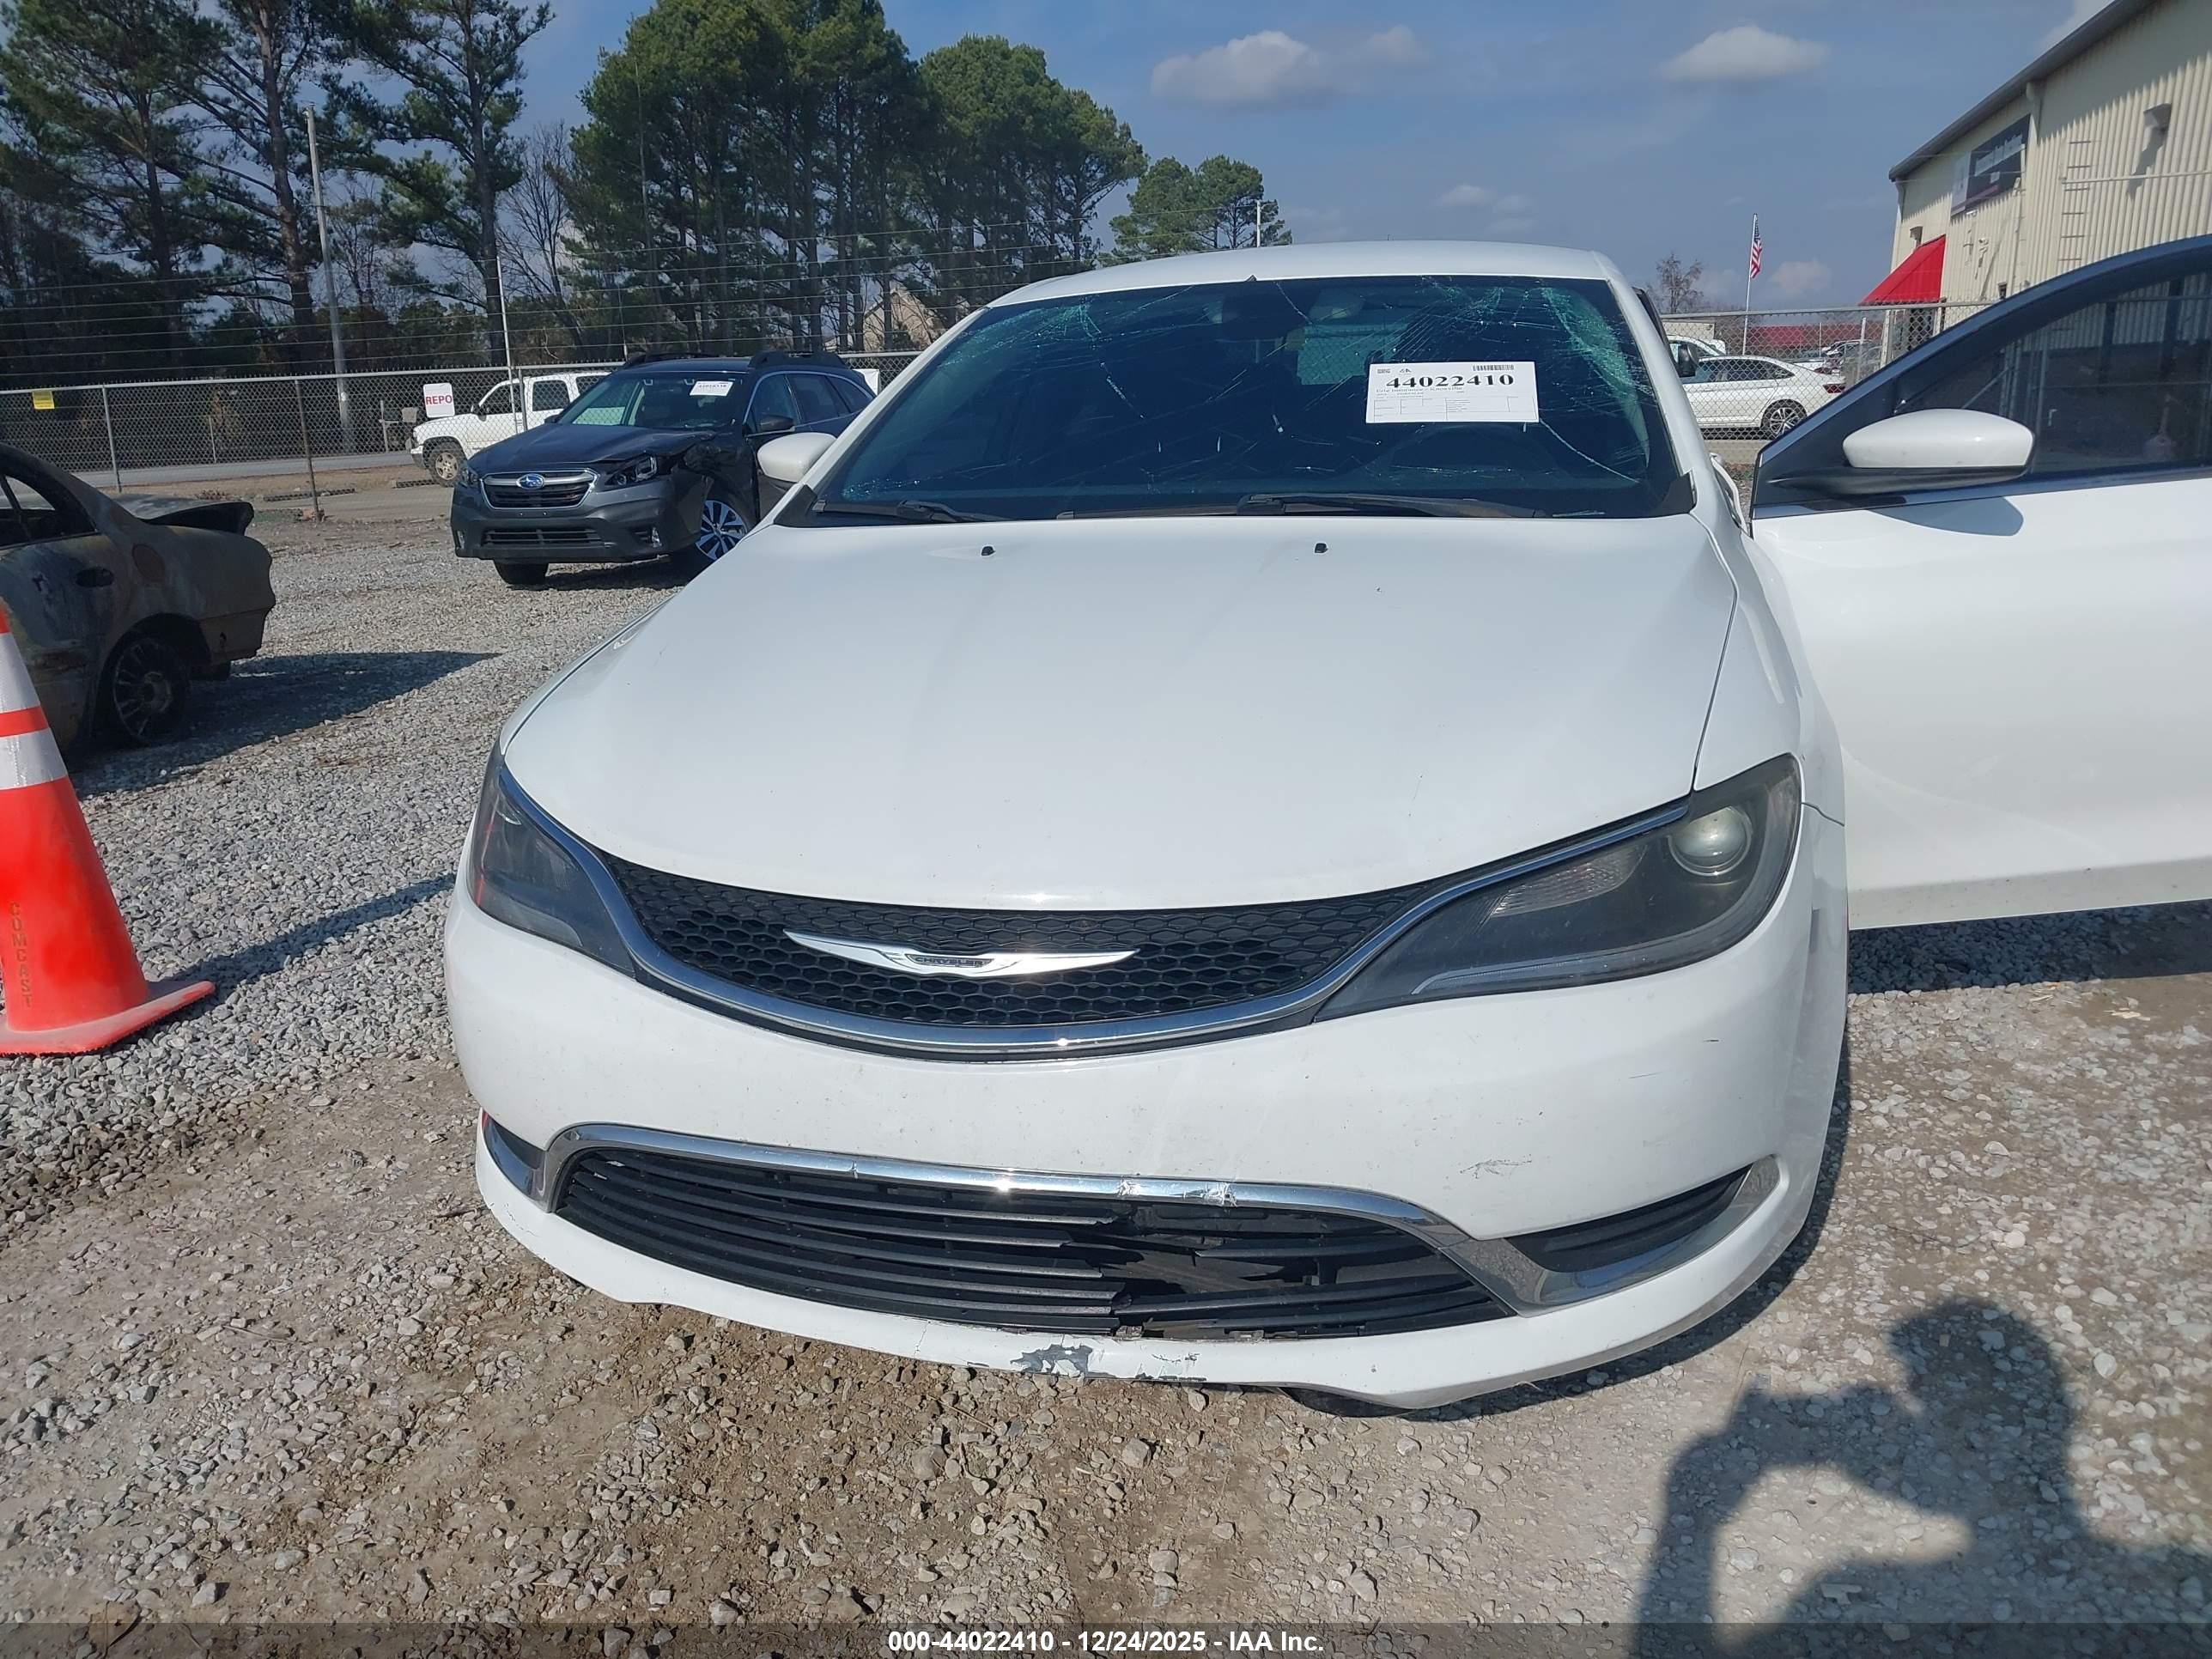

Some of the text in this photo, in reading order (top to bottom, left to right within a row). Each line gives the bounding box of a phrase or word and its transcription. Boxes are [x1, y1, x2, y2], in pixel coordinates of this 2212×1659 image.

[1386, 374, 1514, 387] 44022410
[426, 395, 453, 404] REPO
[9, 902, 32, 1007] COMCAST
